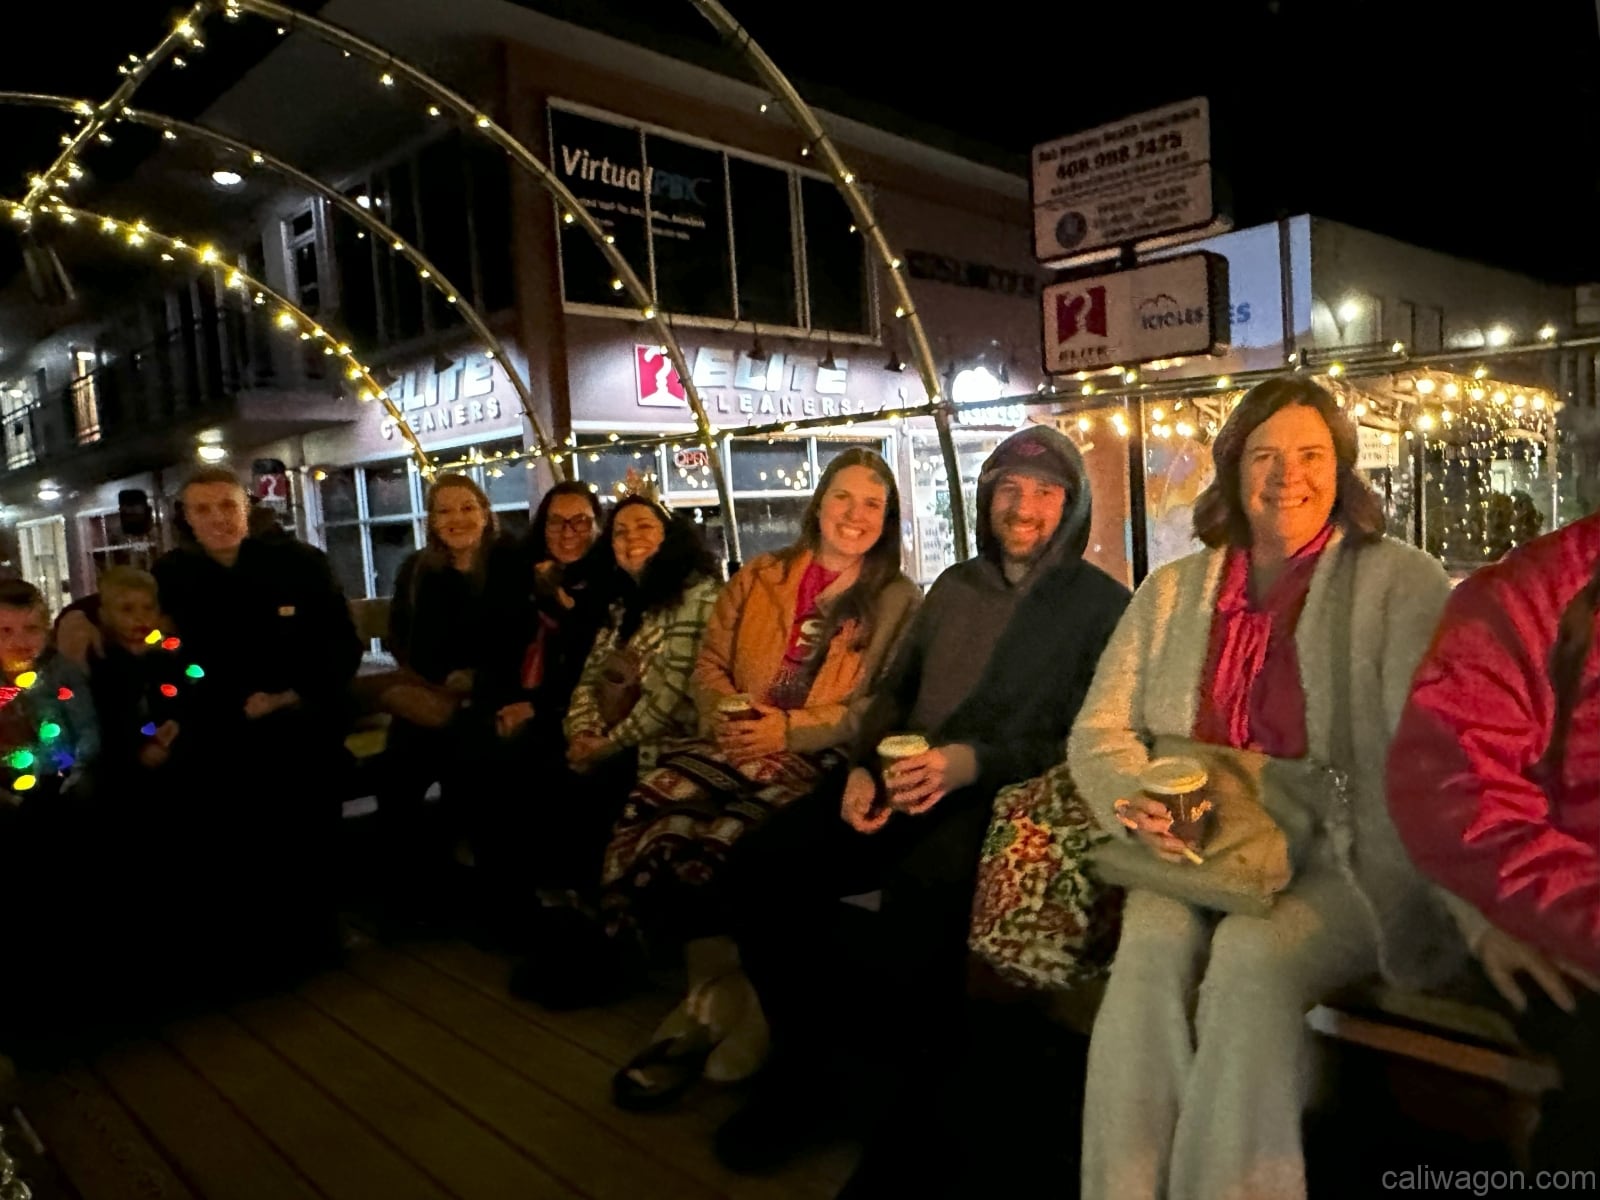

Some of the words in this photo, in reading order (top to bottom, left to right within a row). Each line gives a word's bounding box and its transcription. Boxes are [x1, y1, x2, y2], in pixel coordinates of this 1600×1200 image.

[561, 144, 654, 195] Virtual
[693, 346, 849, 395] ELITE
[381, 397, 500, 440] CEANERS
[677, 451, 709, 467] OPEN
